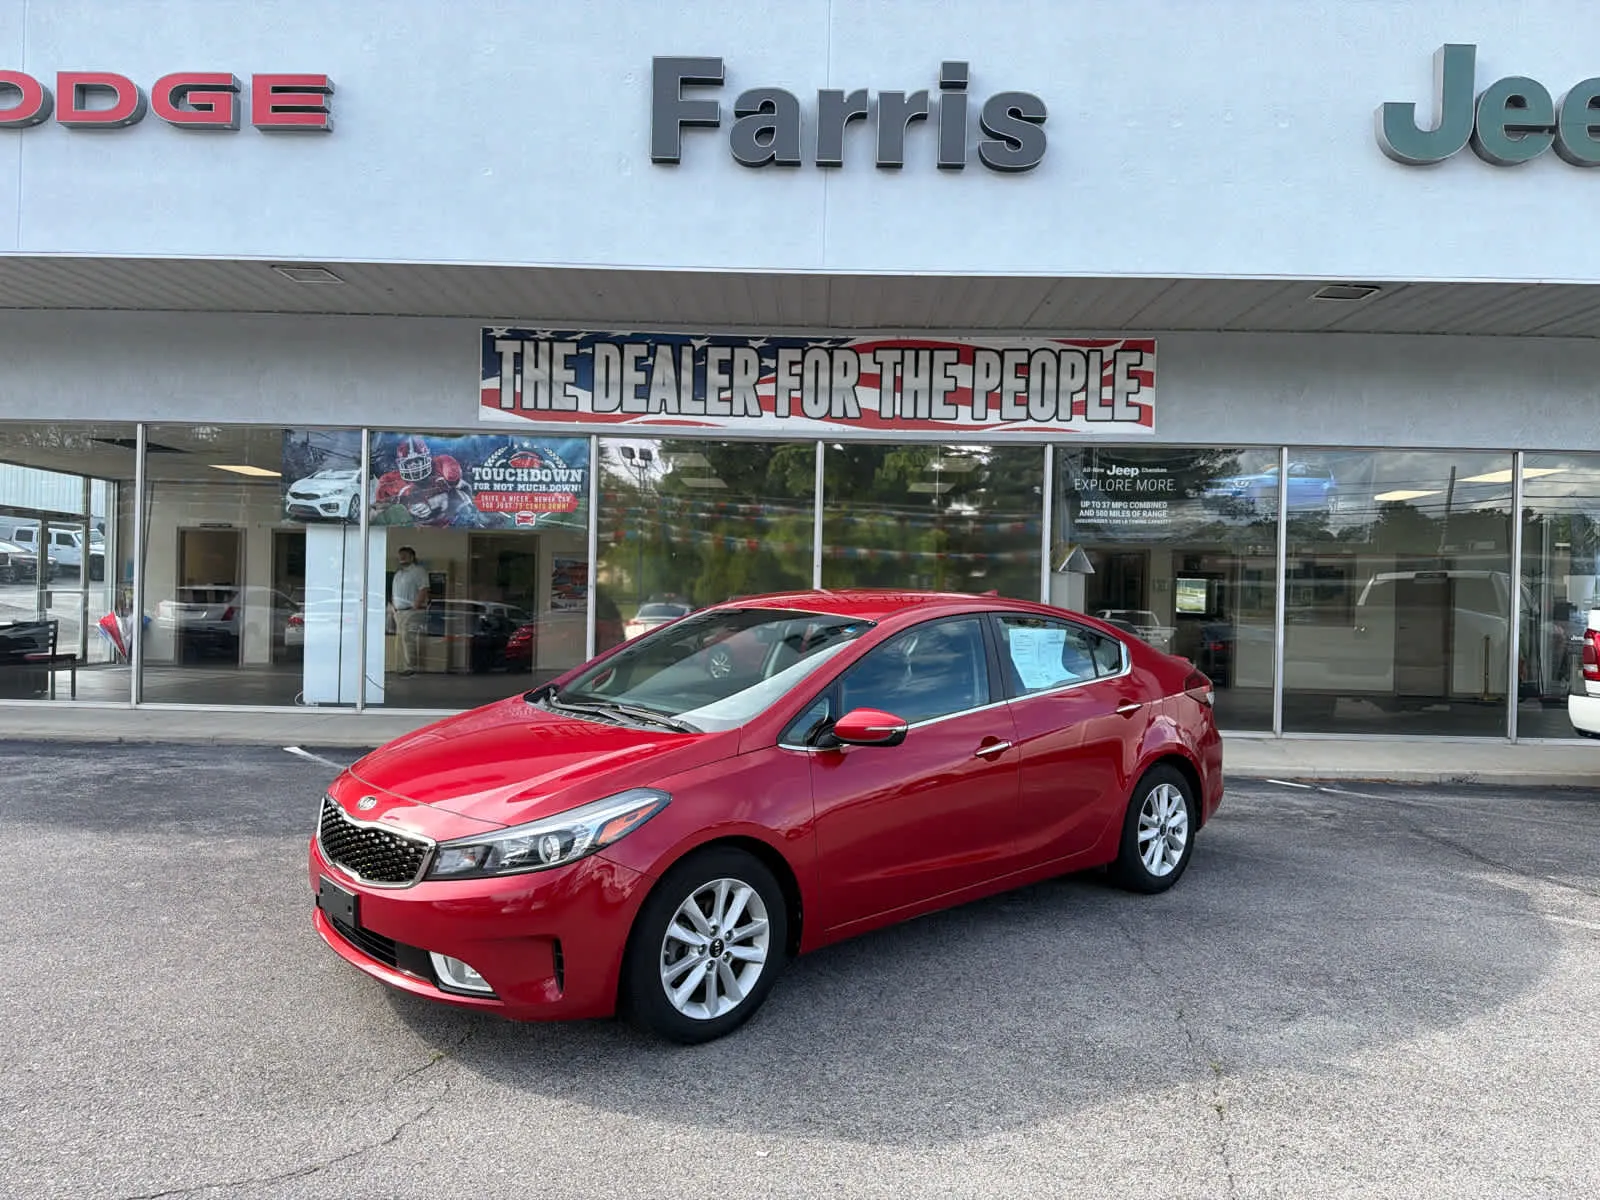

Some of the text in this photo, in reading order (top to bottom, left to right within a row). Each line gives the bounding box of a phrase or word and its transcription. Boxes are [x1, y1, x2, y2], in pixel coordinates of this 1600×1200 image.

[651, 56, 1048, 172] Farris
[495, 338, 1143, 422] THE DEALER FOR THE PEOPLE
[472, 467, 583, 482] TOUCHDOWN
[1106, 464, 1140, 478] Jeep
[473, 482, 582, 493] FOR NOT MUCH DOWN!
[1074, 478, 1177, 492] EXPLORE MORE.
[1111, 501, 1128, 509] MPG
[1129, 501, 1168, 509] COMBINED
[1079, 509, 1095, 517] AND
